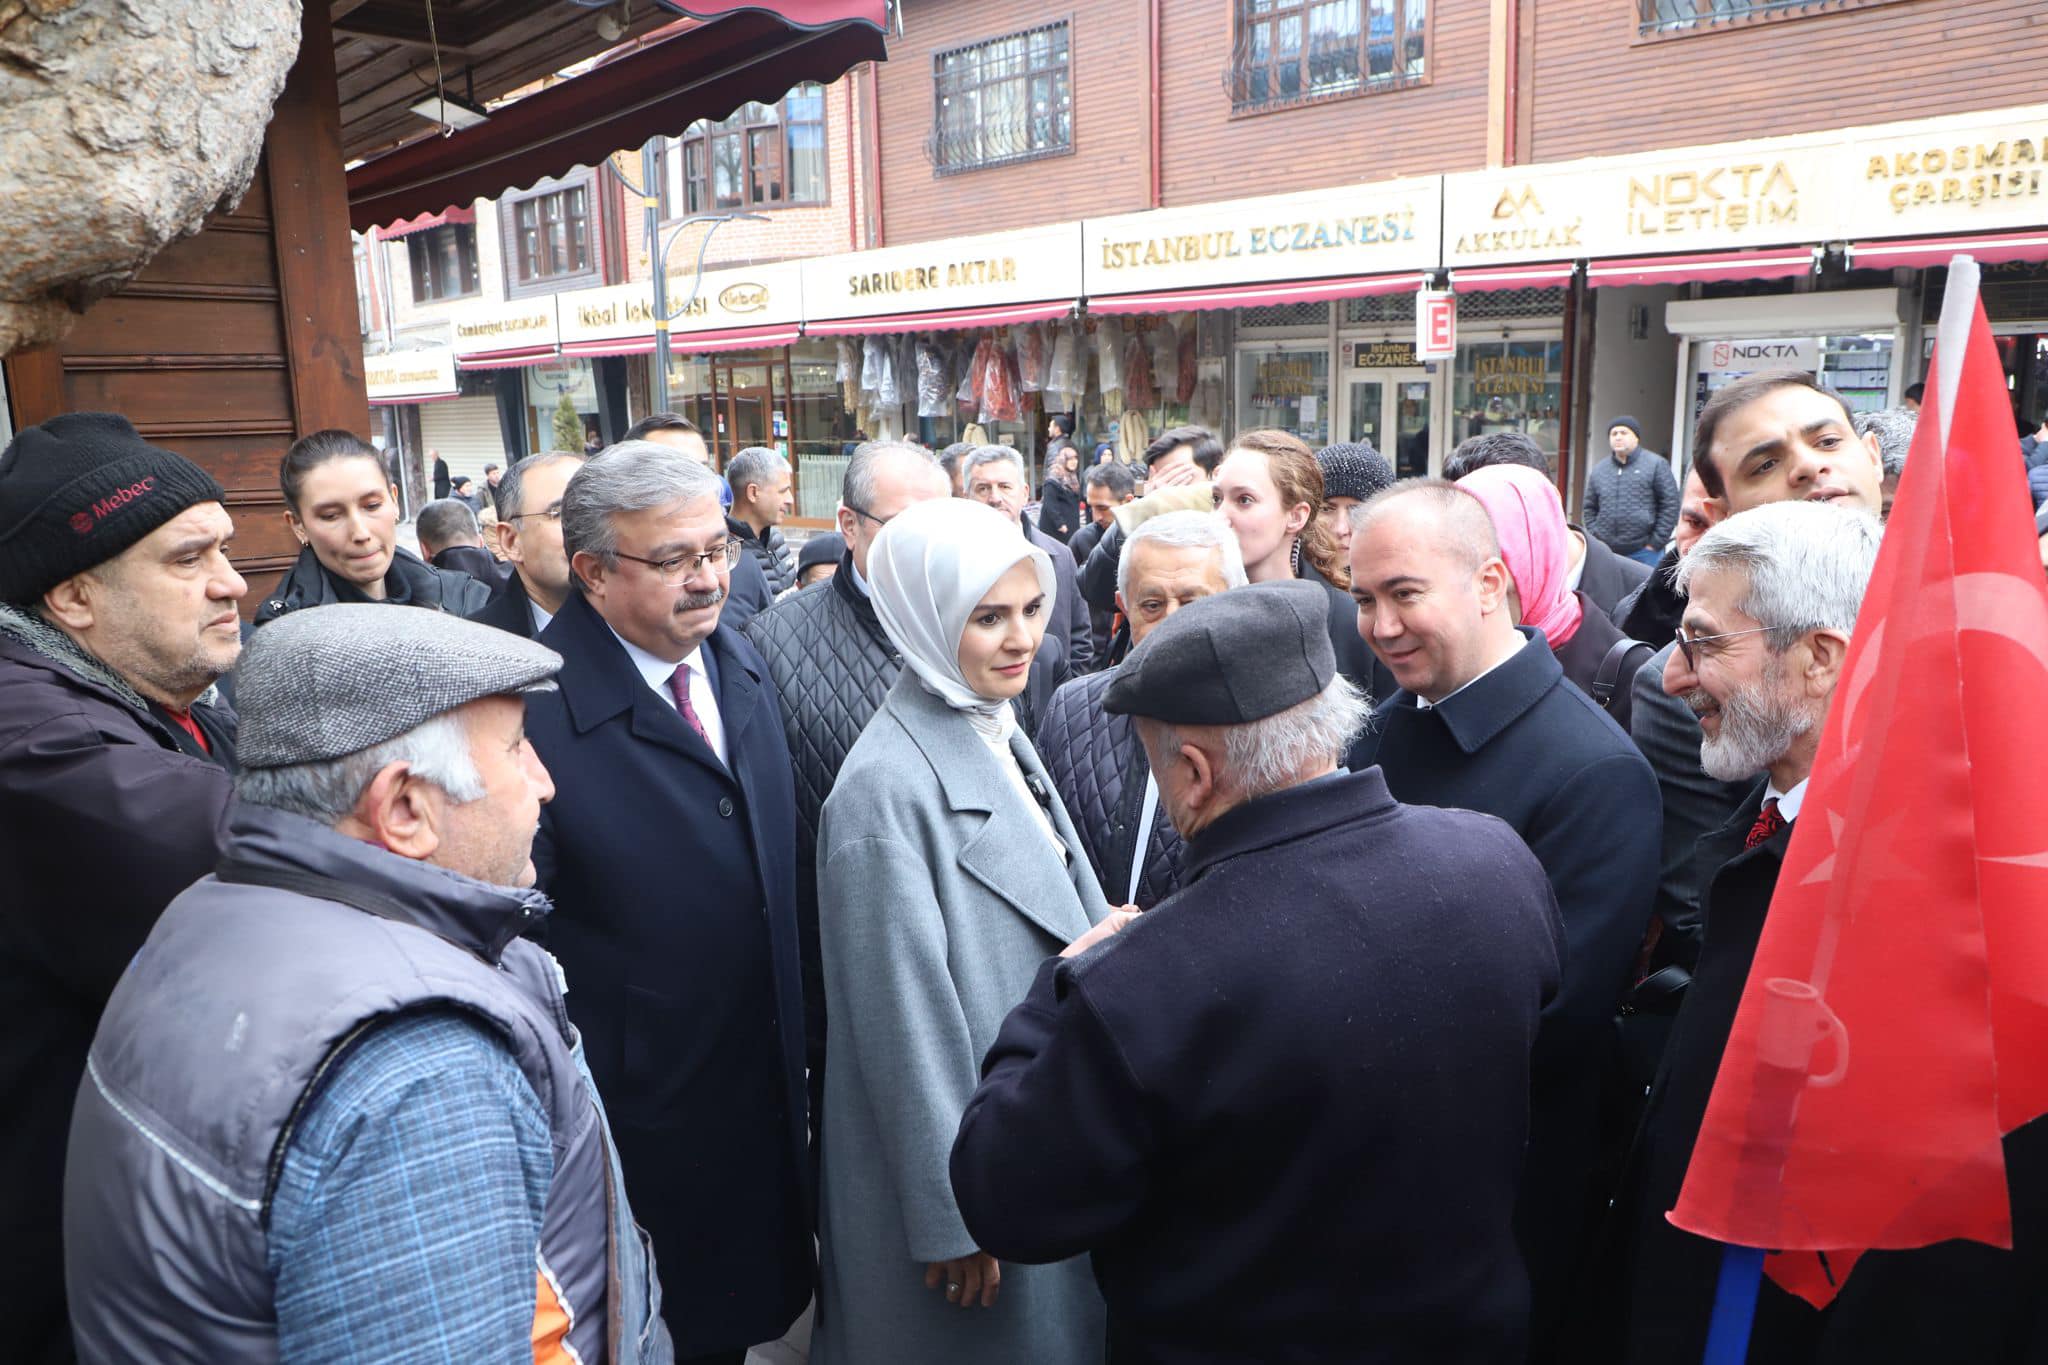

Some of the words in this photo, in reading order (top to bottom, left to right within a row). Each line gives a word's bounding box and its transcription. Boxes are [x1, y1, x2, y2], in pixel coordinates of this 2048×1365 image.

[1867, 137, 2048, 180] AKOSMA
[1627, 159, 1799, 209] NOKTA
[1101, 229, 1242, 270] İSTANBUL
[1249, 202, 1416, 256] ECZANESİ
[1454, 223, 1583, 254] AKKULAK
[848, 264, 939, 297] SARIDERE
[946, 255, 1018, 287] AKTAR
[1431, 306, 1449, 345] E
[1358, 352, 1424, 367] ECZANES
[1732, 344, 1800, 359] NOKTA
